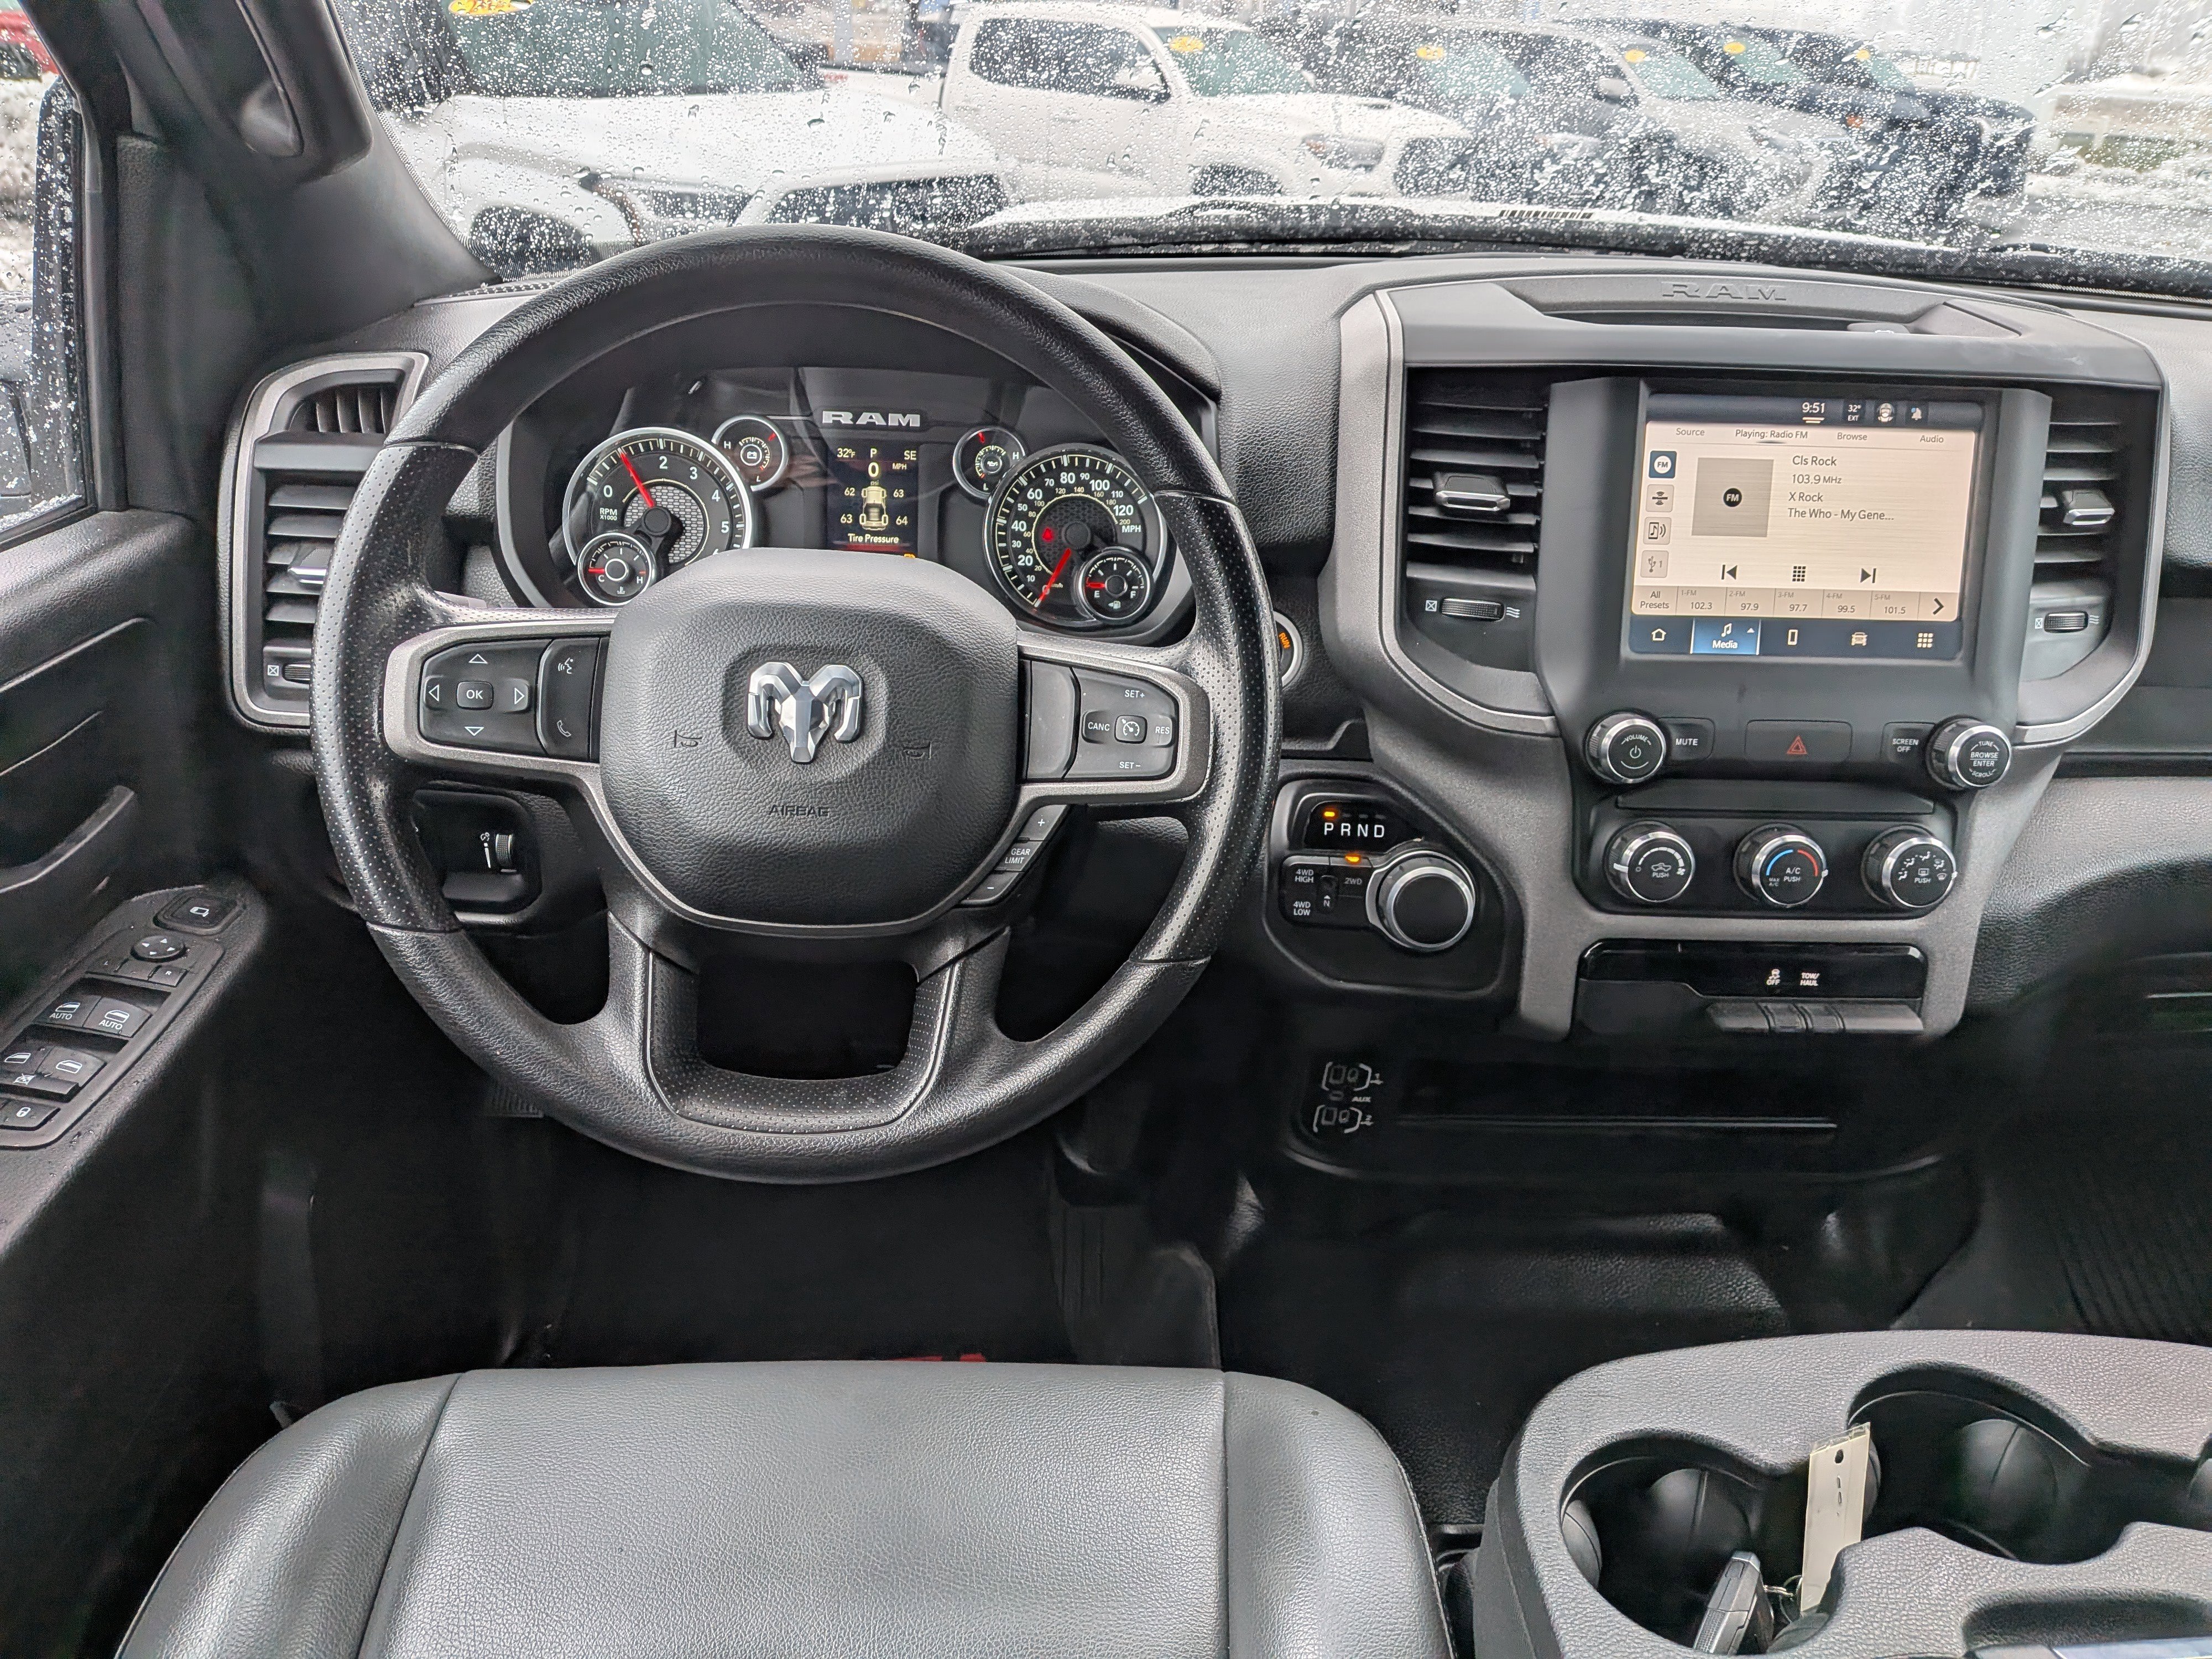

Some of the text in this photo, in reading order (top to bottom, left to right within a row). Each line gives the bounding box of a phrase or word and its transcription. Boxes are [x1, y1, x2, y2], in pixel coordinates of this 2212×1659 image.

[1661, 281, 1787, 301] RAM
[1802, 401, 1825, 414] 9:51
[1848, 404, 1861, 413] 32°
[822, 410, 920, 427] RAM
[1676, 428, 1704, 436] Source
[1735, 429, 1808, 440] Playing: Radio FM
[1837, 432, 1867, 441] Browse
[1919, 435, 1944, 444] Audio
[724, 441, 731, 449] H
[837, 447, 855, 458] 32°F
[870, 448, 877, 458] P
[904, 451, 916, 461] SE
[659, 457, 667, 469] 2
[1792, 456, 1837, 467] Cls Rock
[690, 467, 698, 479] 3
[868, 462, 879, 477] 0
[1060, 472, 1076, 484] 80
[1792, 474, 1841, 484] 103.9 MHz
[1089, 480, 1110, 491] 100
[604, 486, 612, 498] 0
[712, 489, 720, 502] 4
[844, 487, 855, 497] 62
[893, 489, 904, 498] 63
[1027, 488, 1042, 500] 60
[1726, 494, 1740, 502] FM
[1788, 492, 1823, 503] X Rock
[599, 508, 617, 516] RPM
[1113, 505, 1134, 516] 120
[1788, 508, 1807, 519] The
[1809, 509, 1831, 519] Who
[1840, 509, 1856, 523] My
[840, 514, 853, 524] 63
[896, 516, 907, 525] 64
[721, 521, 729, 533] 5
[1011, 520, 1027, 531] 40
[1121, 525, 1141, 533] MPH
[848, 533, 899, 543] Tire Pressure
[1018, 555, 1033, 566] 20
[1650, 591, 1661, 599] All
[1729, 589, 1745, 598] 2-FM
[1778, 591, 1794, 599] 3-FM
[1640, 601, 1669, 610] Presets
[1690, 601, 1713, 611] 102.3
[1741, 602, 1759, 612] 97.9
[1789, 603, 1807, 612] 97.7
[1837, 604, 1855, 613] 99.5
[1884, 605, 1906, 614] 101.5
[1279, 632, 1291, 649] RUN
[1712, 639, 1738, 649] Media
[466, 690, 483, 700] OK
[1088, 722, 1110, 731] CANC
[1155, 726, 1170, 734] RES
[769, 805, 831, 817] AIRBAG
[1324, 822, 1385, 838] P R N D
[99, 1019, 123, 1030] AUTO
